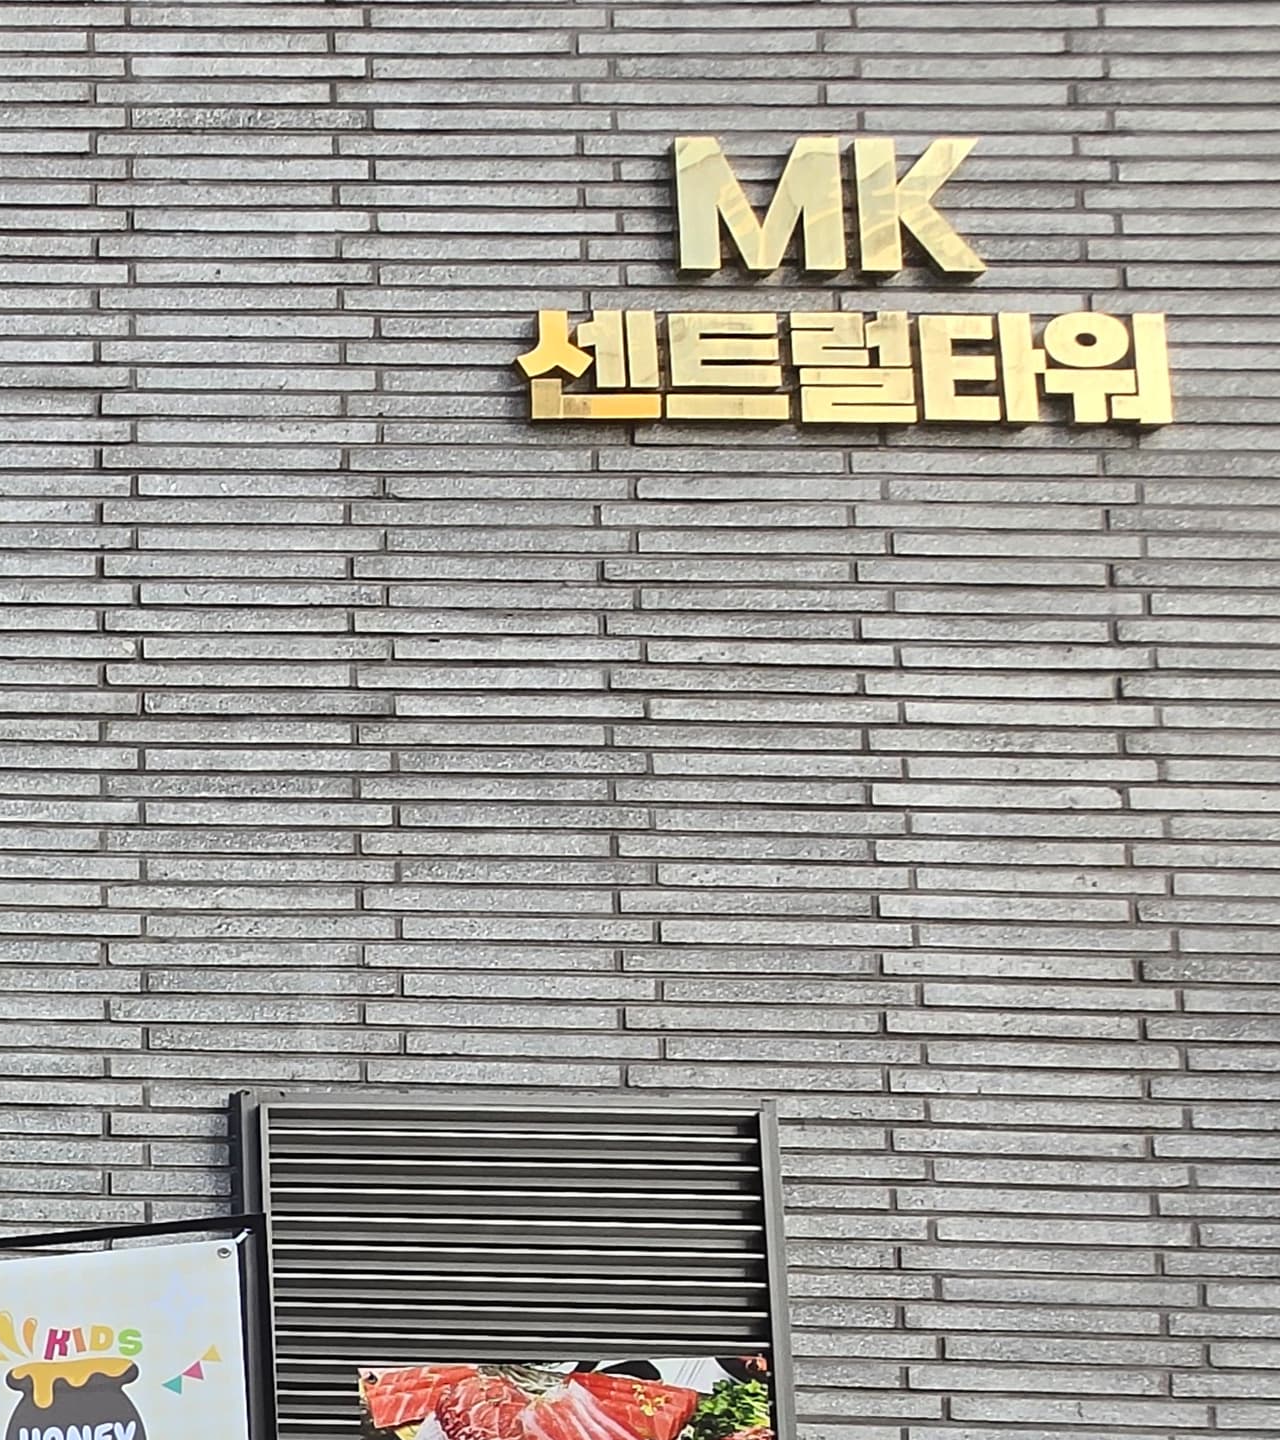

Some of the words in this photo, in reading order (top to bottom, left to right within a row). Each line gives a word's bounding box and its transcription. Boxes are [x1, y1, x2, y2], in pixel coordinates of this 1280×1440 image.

[670, 137, 987, 273] MK
[517, 309, 1173, 425] 센트럴타워
[44, 1325, 143, 1360] KIDS
